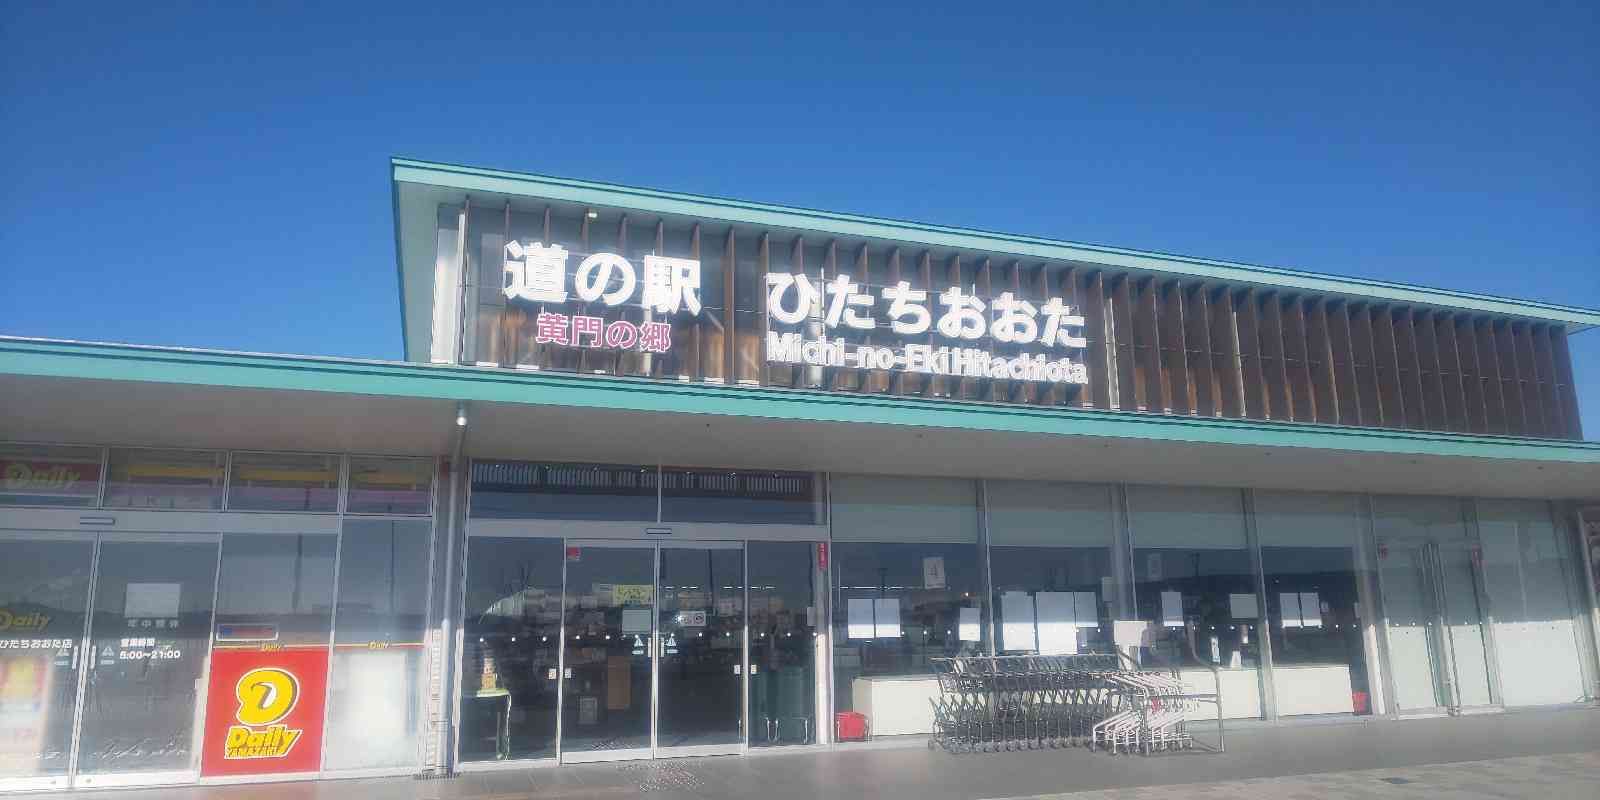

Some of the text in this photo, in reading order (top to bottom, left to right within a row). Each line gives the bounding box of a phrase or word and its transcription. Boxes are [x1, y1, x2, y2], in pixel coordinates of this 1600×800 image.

[503, 239, 1087, 348] 道の駅 ひたちおおた
[536, 311, 671, 353] 黄門の郷
[766, 331, 1088, 385] Michi-no-Eki Hitachiota
[7, 463, 81, 490] Daily
[369, 640, 390, 650] Daily
[227, 724, 302, 757] Daily
